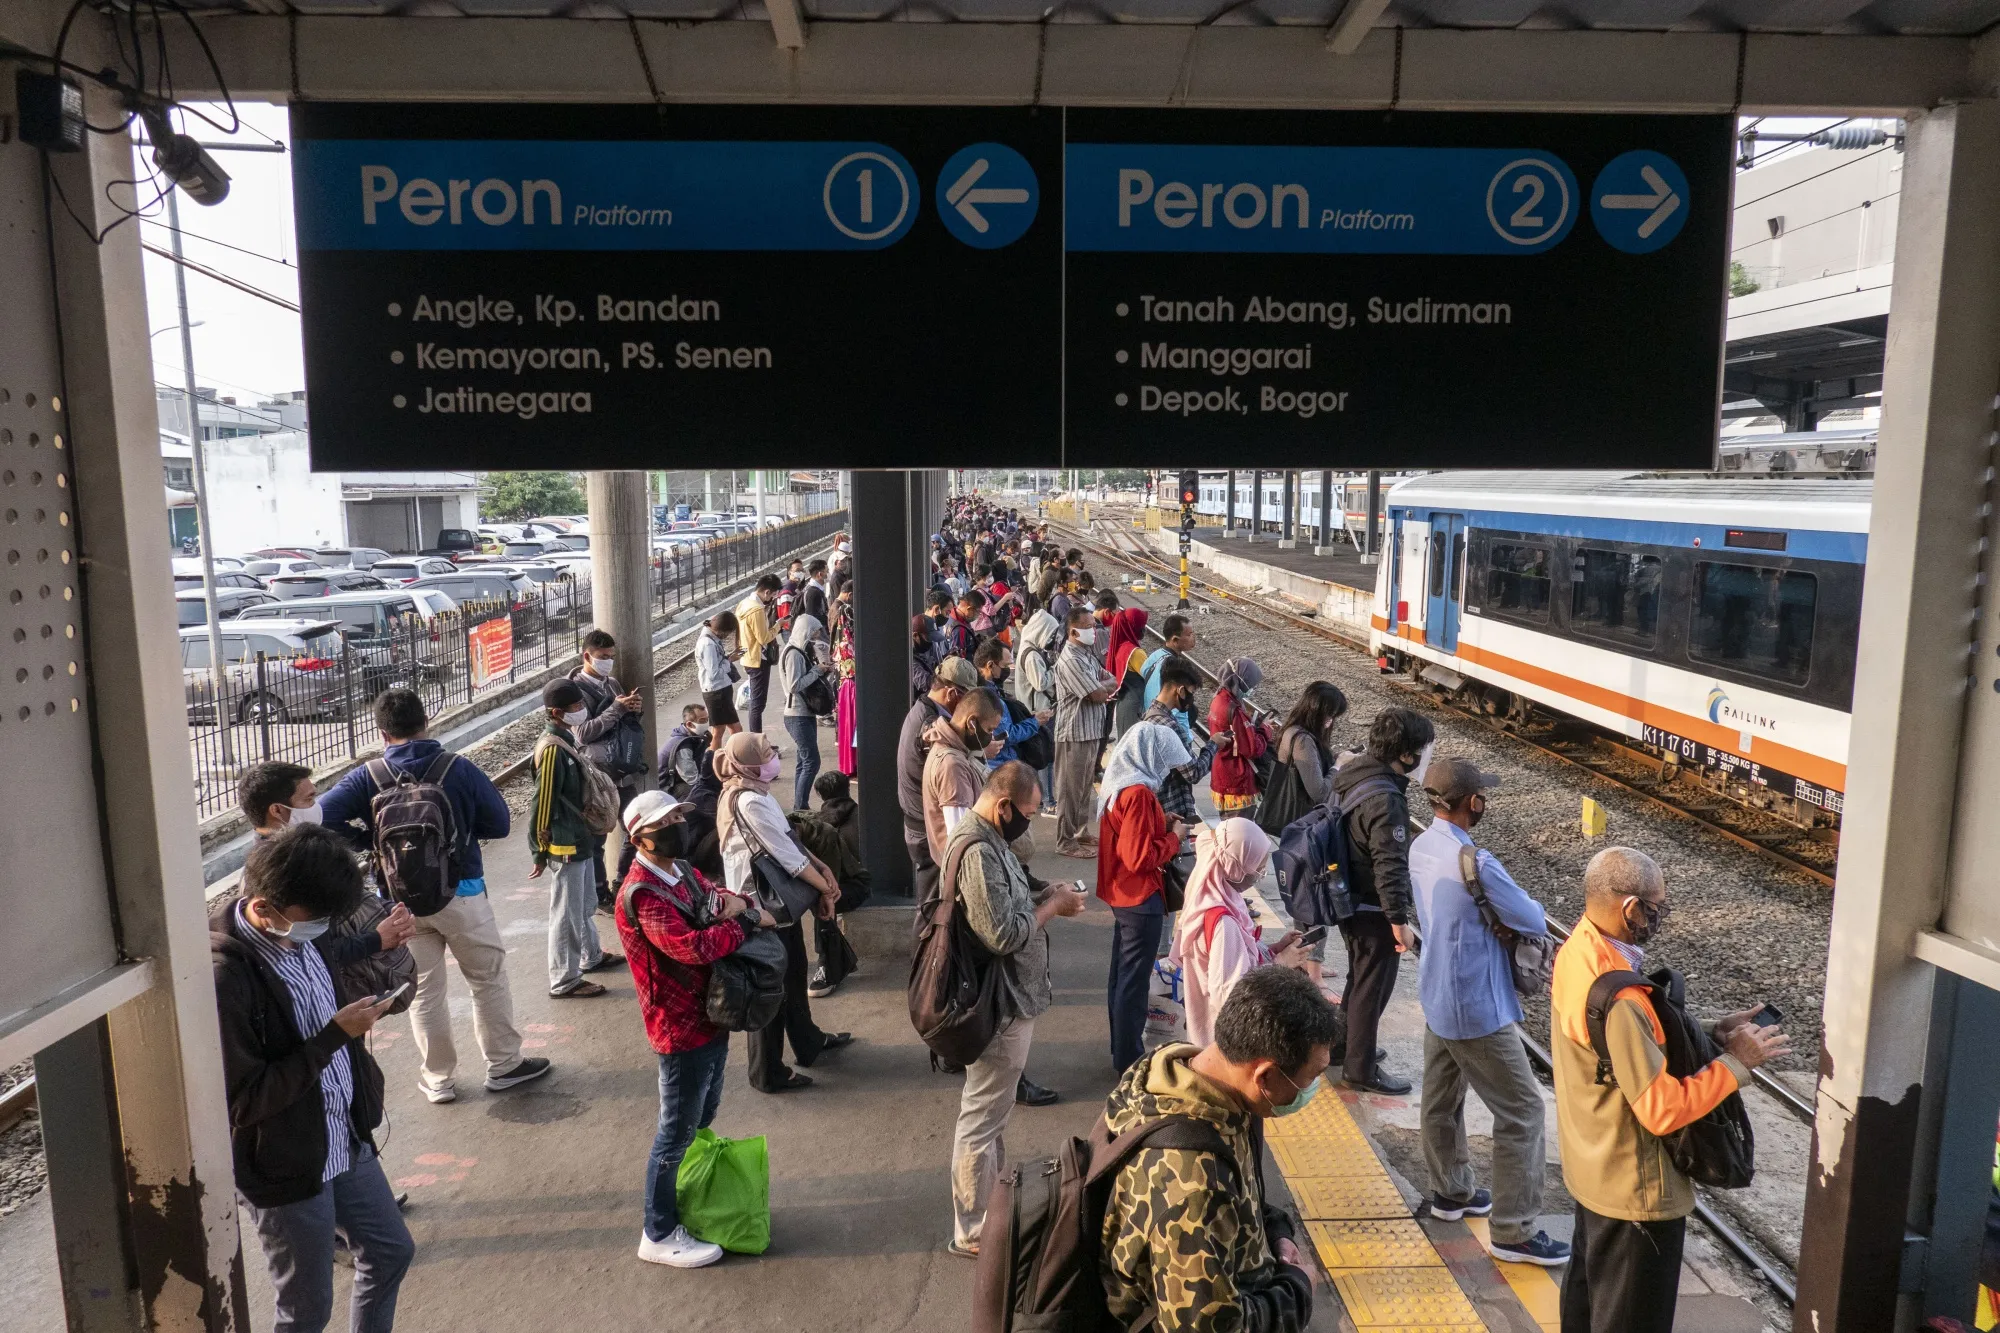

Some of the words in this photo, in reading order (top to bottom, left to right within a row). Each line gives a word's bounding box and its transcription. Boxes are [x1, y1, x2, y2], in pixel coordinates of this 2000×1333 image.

[362, 165, 563, 227] Peron
[574, 206, 673, 227] Platform
[857, 170, 874, 224] 1
[1120, 168, 1310, 229] Peron
[1319, 209, 1415, 230] Platform
[1511, 175, 1543, 227] 2
[414, 296, 523, 328] Angke,
[537, 296, 585, 328] Kp.
[599, 296, 720, 322] Bandan
[1141, 296, 1235, 323] Tanah
[1245, 297, 1357, 331] Abang,
[1368, 297, 1512, 325] Sudirman
[417, 344, 611, 376] Kemayoran,
[623, 343, 664, 370] PS.
[676, 343, 773, 370] Senen
[1142, 343, 1312, 376] Manggarai
[420, 387, 593, 421] Jatinegara
[1141, 387, 1249, 418] Depok,
[1261, 387, 1349, 419] Bogor
[1724, 706, 1776, 731] RAILINK
[1707, 757, 1716, 766] TP
[1720, 761, 1735, 773] 2017
[1739, 758, 1751, 770] KG
